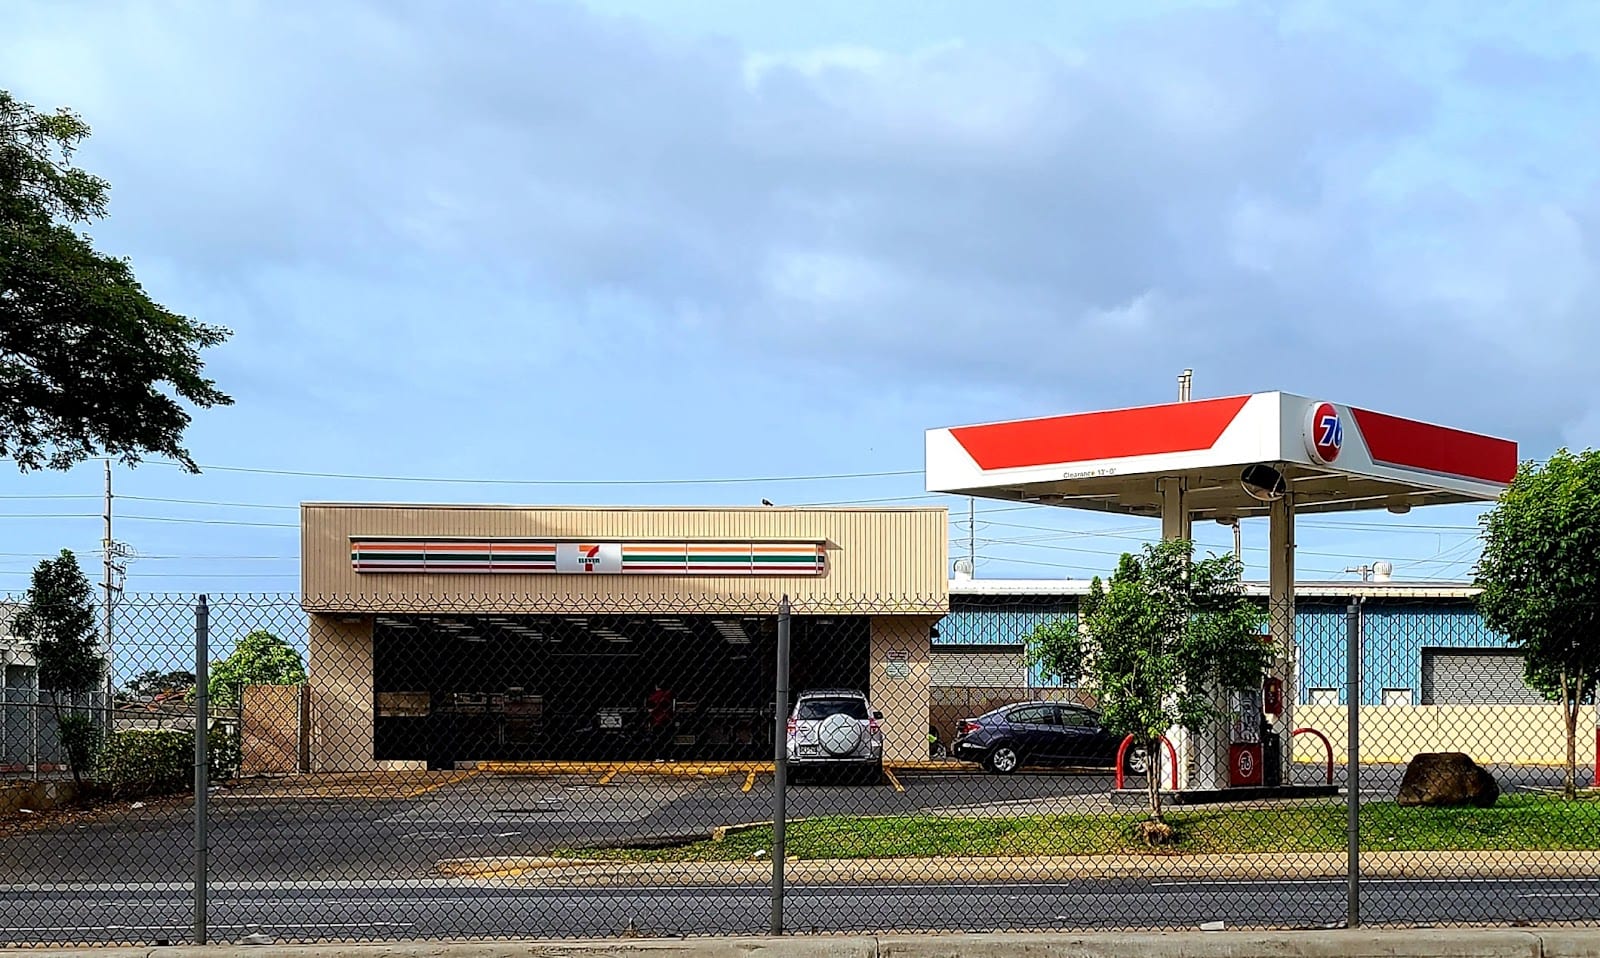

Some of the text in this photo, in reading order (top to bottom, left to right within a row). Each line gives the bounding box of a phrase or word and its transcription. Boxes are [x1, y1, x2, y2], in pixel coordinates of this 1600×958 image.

[1319, 415, 1343, 449] 76
[1063, 471, 1095, 479] Clearance
[579, 545, 600, 571] 7
